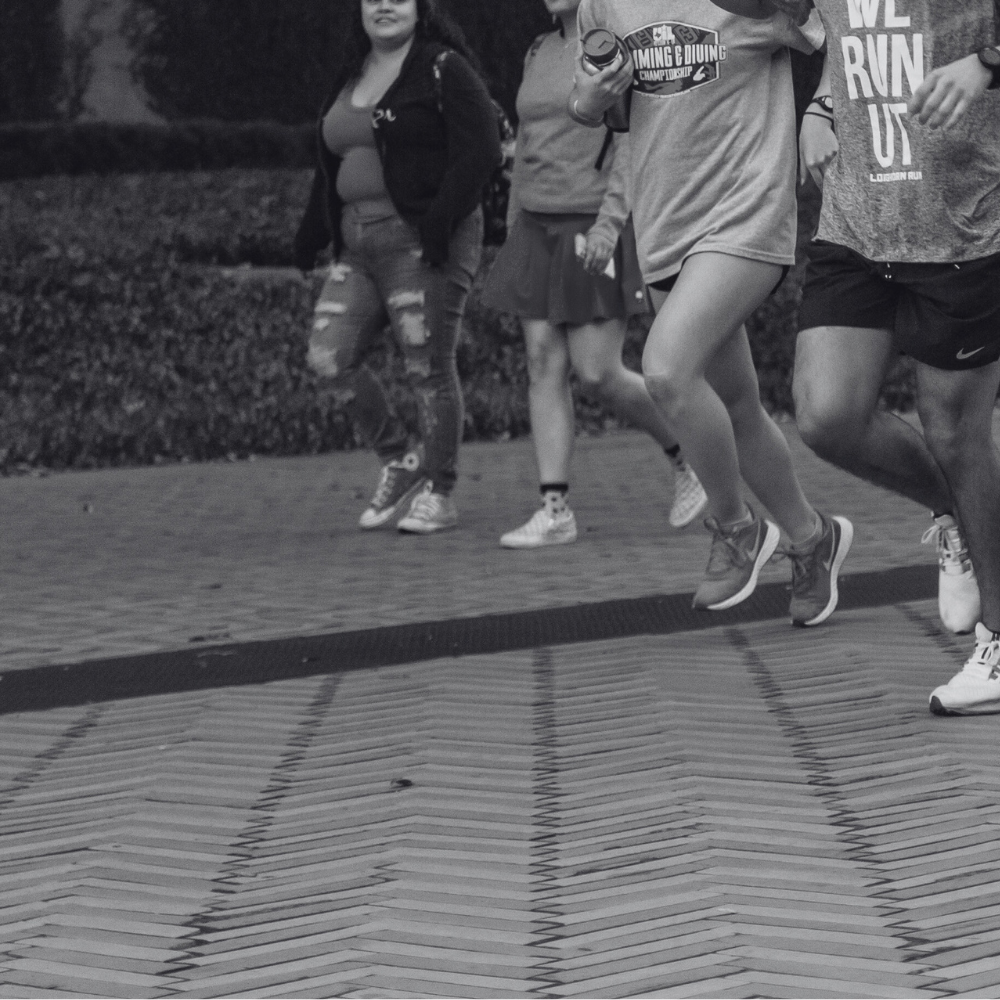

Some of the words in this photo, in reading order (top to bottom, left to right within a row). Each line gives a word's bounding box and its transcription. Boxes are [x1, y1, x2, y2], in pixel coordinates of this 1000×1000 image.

[640, 66, 693, 81] CHAMPIONSHIP
[674, 45, 683, 67] &
[841, 33, 924, 100] RUN
[867, 103, 912, 168] UT
